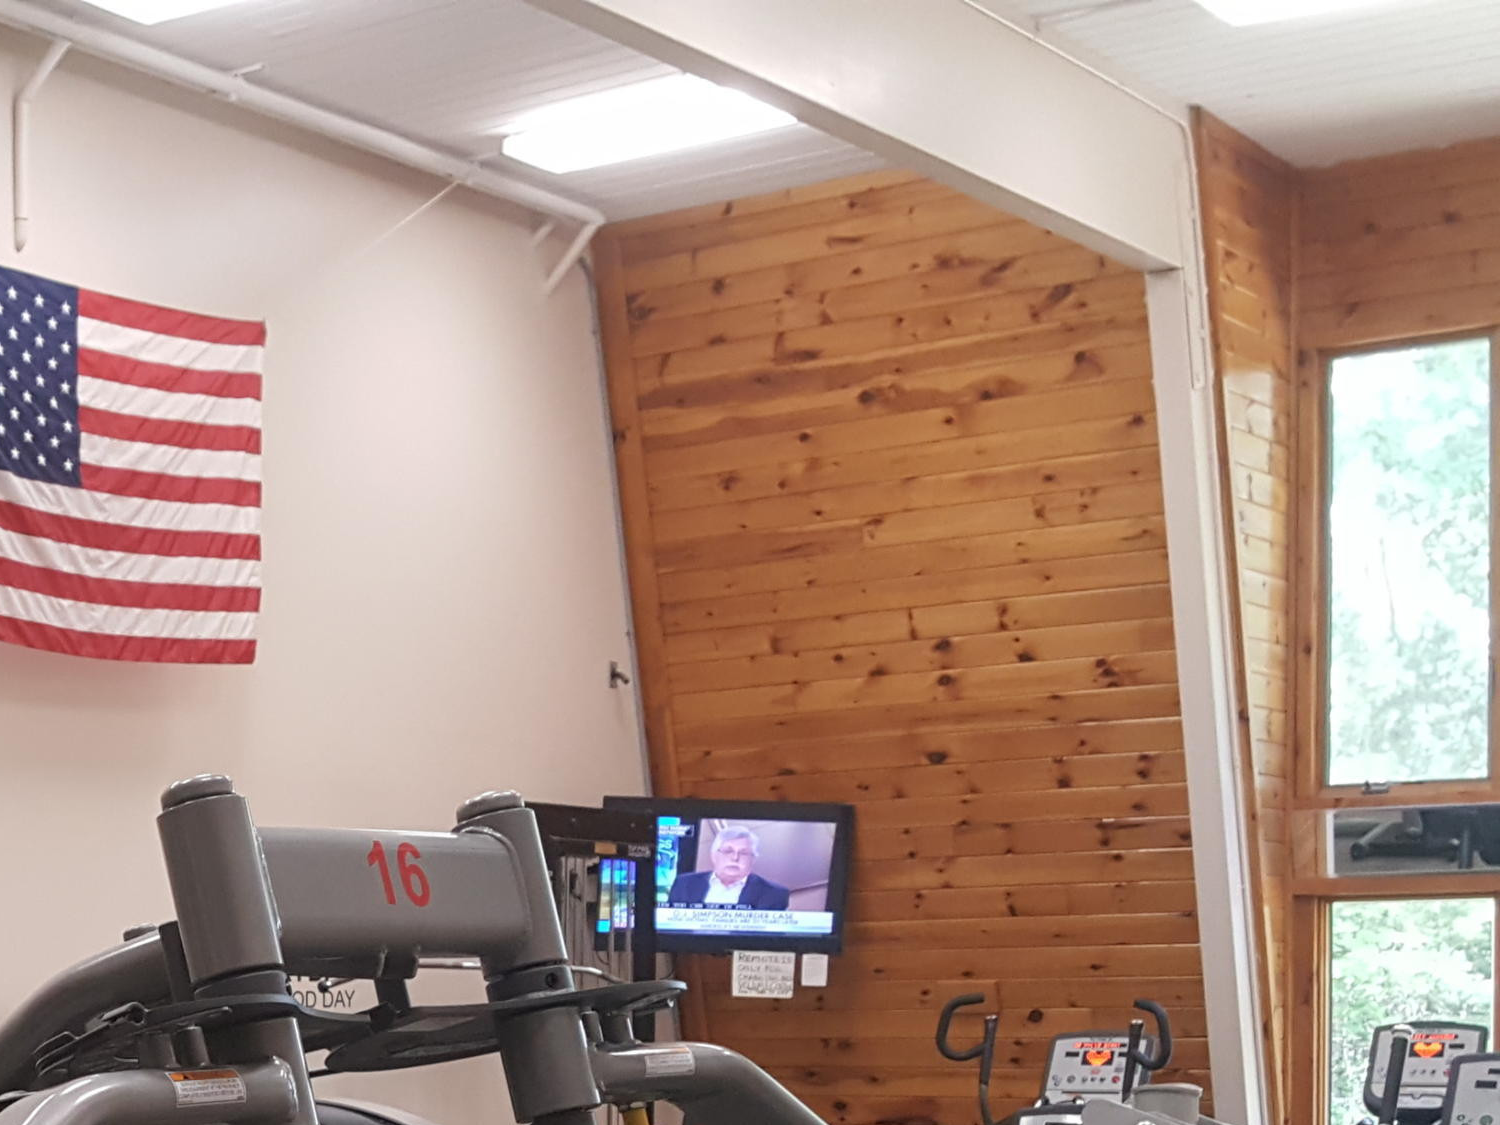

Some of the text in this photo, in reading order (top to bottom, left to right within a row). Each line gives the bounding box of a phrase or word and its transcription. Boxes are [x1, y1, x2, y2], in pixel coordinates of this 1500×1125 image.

[367, 840, 431, 907] 16
[293, 990, 355, 1008] OD DAY
